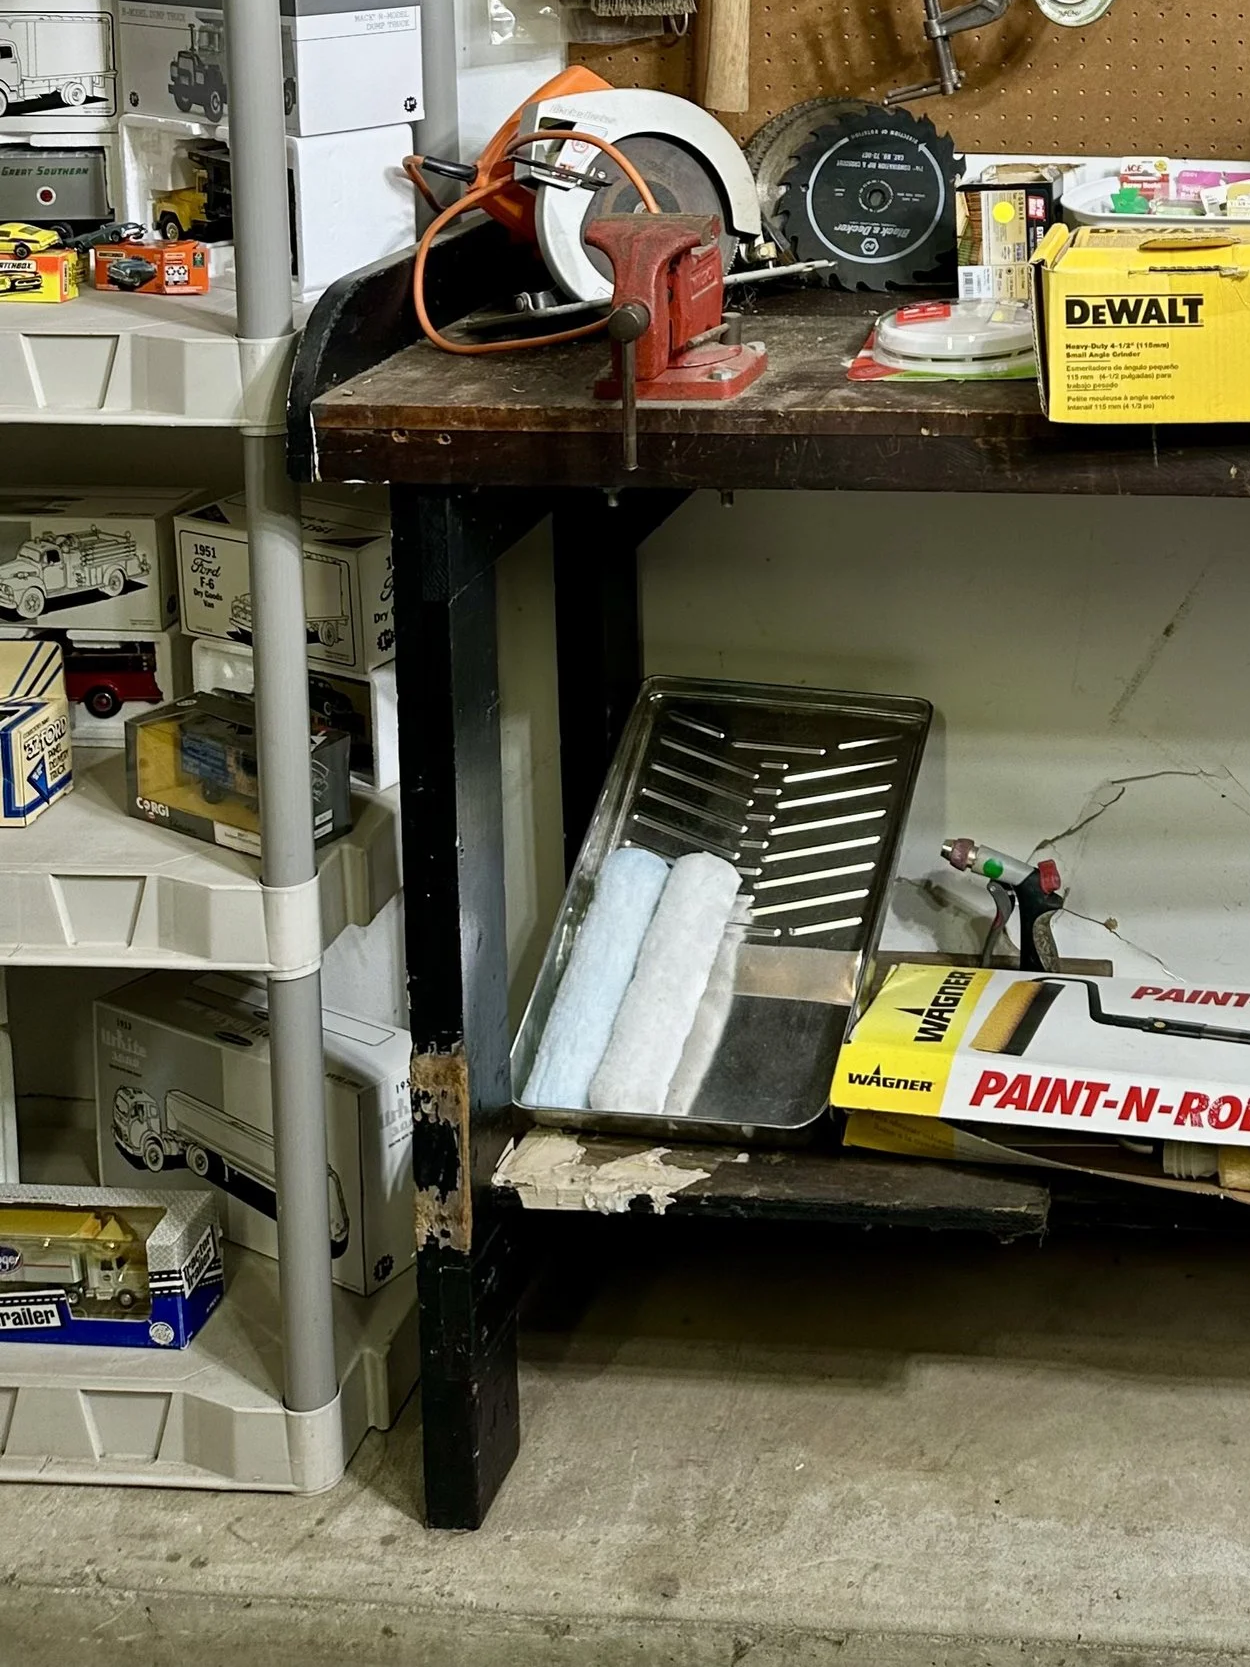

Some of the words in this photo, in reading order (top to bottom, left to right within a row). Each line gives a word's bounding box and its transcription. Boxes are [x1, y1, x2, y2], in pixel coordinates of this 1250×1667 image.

[1, 166, 33, 176] GREAT
[36, 166, 89, 176] SOUTHERN
[1125, 164, 1142, 172] ACE
[834, 223, 871, 236] Decker
[879, 226, 910, 239] Black
[1093, 382, 1118, 390] pesado
[193, 543, 216, 559] 1951
[190, 557, 221, 578] Ford
[200, 576, 215, 590] F-6
[193, 588, 204, 599] Dry
[204, 590, 223, 602] Goods
[203, 599, 215, 609] Van
[374, 611, 389, 624] Dry
[38, 715, 69, 752] FORD
[135, 796, 169, 817] CORGI
[912, 971, 975, 1044] WAGNER
[396, 1078, 411, 1094] 195
[847, 1067, 934, 1093] WAGNER
[0, 1306, 55, 1327] railer
